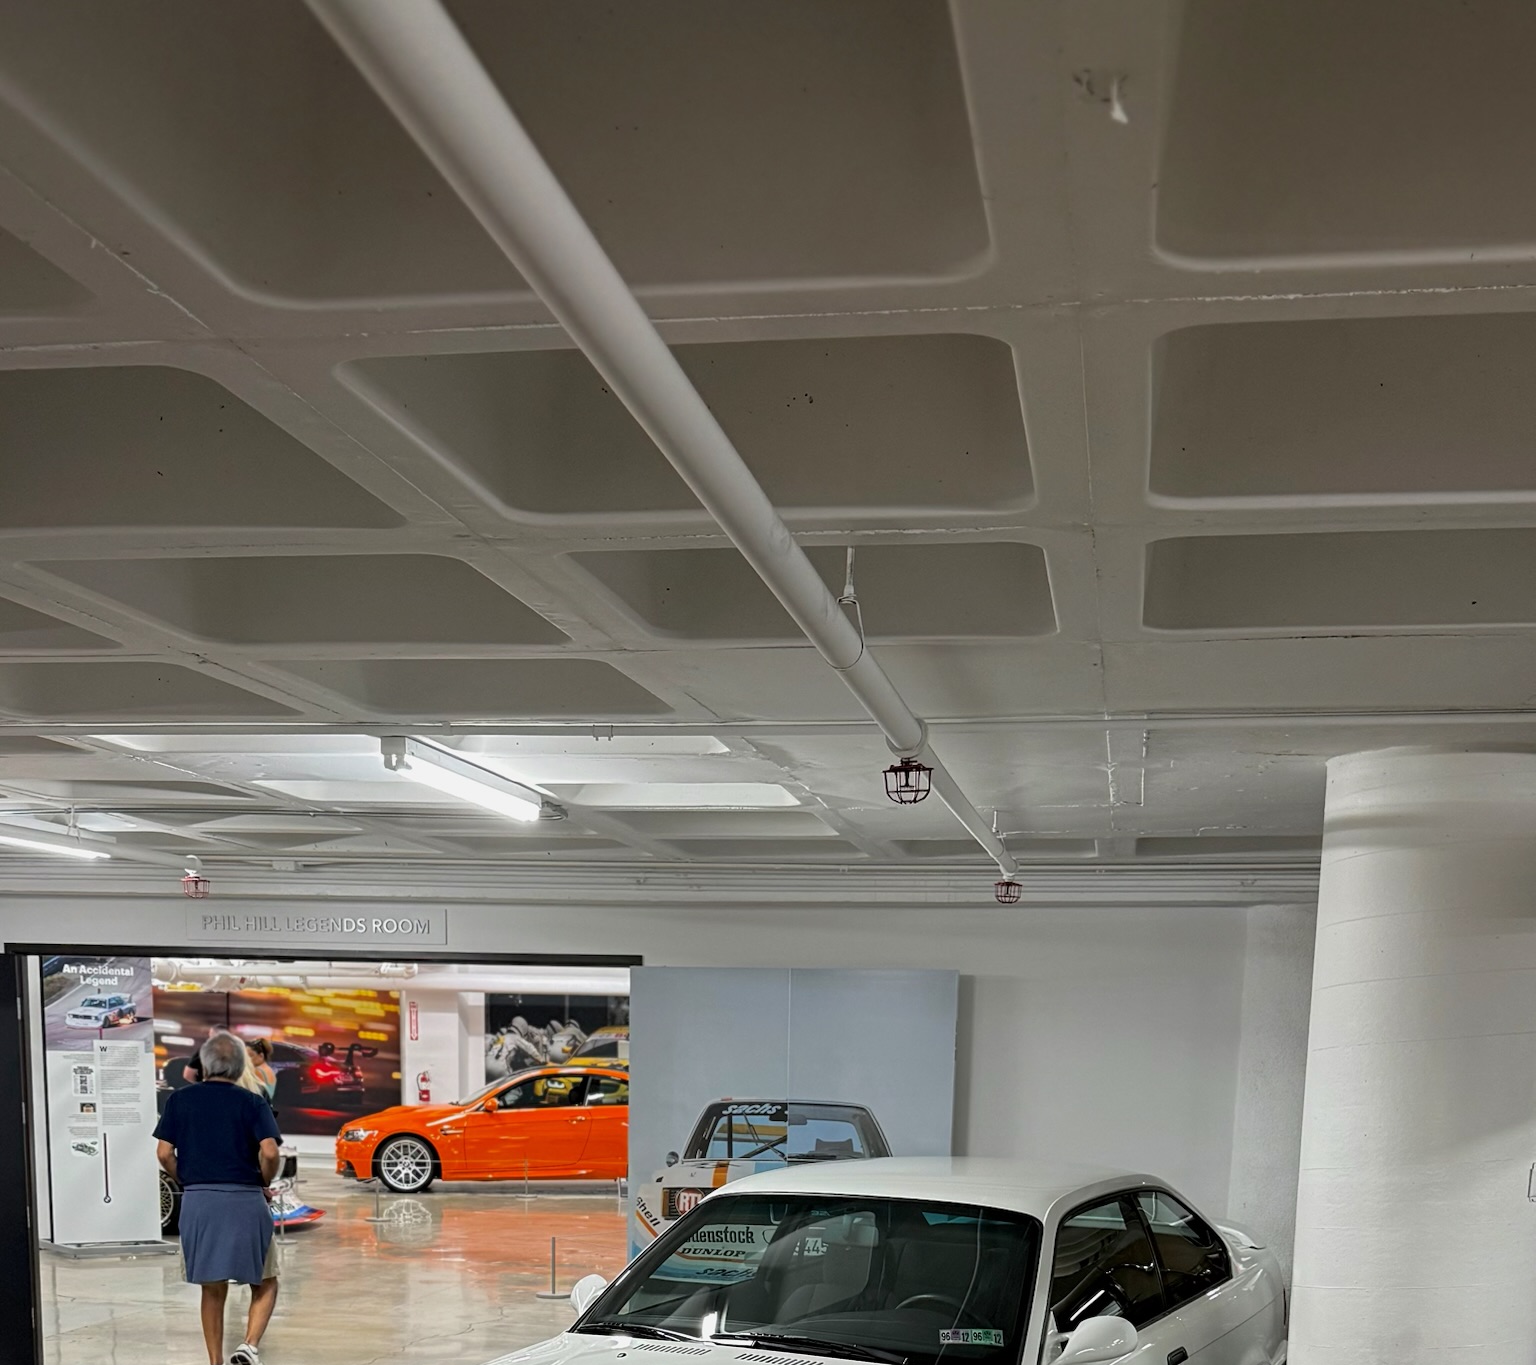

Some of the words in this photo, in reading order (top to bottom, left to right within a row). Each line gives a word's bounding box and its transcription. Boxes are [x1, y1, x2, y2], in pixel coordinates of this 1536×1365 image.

[202, 914, 241, 931] PHIL
[245, 914, 282, 932] HILL
[285, 916, 367, 934] LEGENDS
[371, 917, 431, 935] ROOM
[62, 963, 77, 974] An
[79, 965, 134, 976] Accidental
[80, 976, 118, 987] Legend
[636, 1196, 662, 1227] Shell
[686, 1226, 756, 1244] denstock
[681, 1247, 746, 1258] DUNLOP
